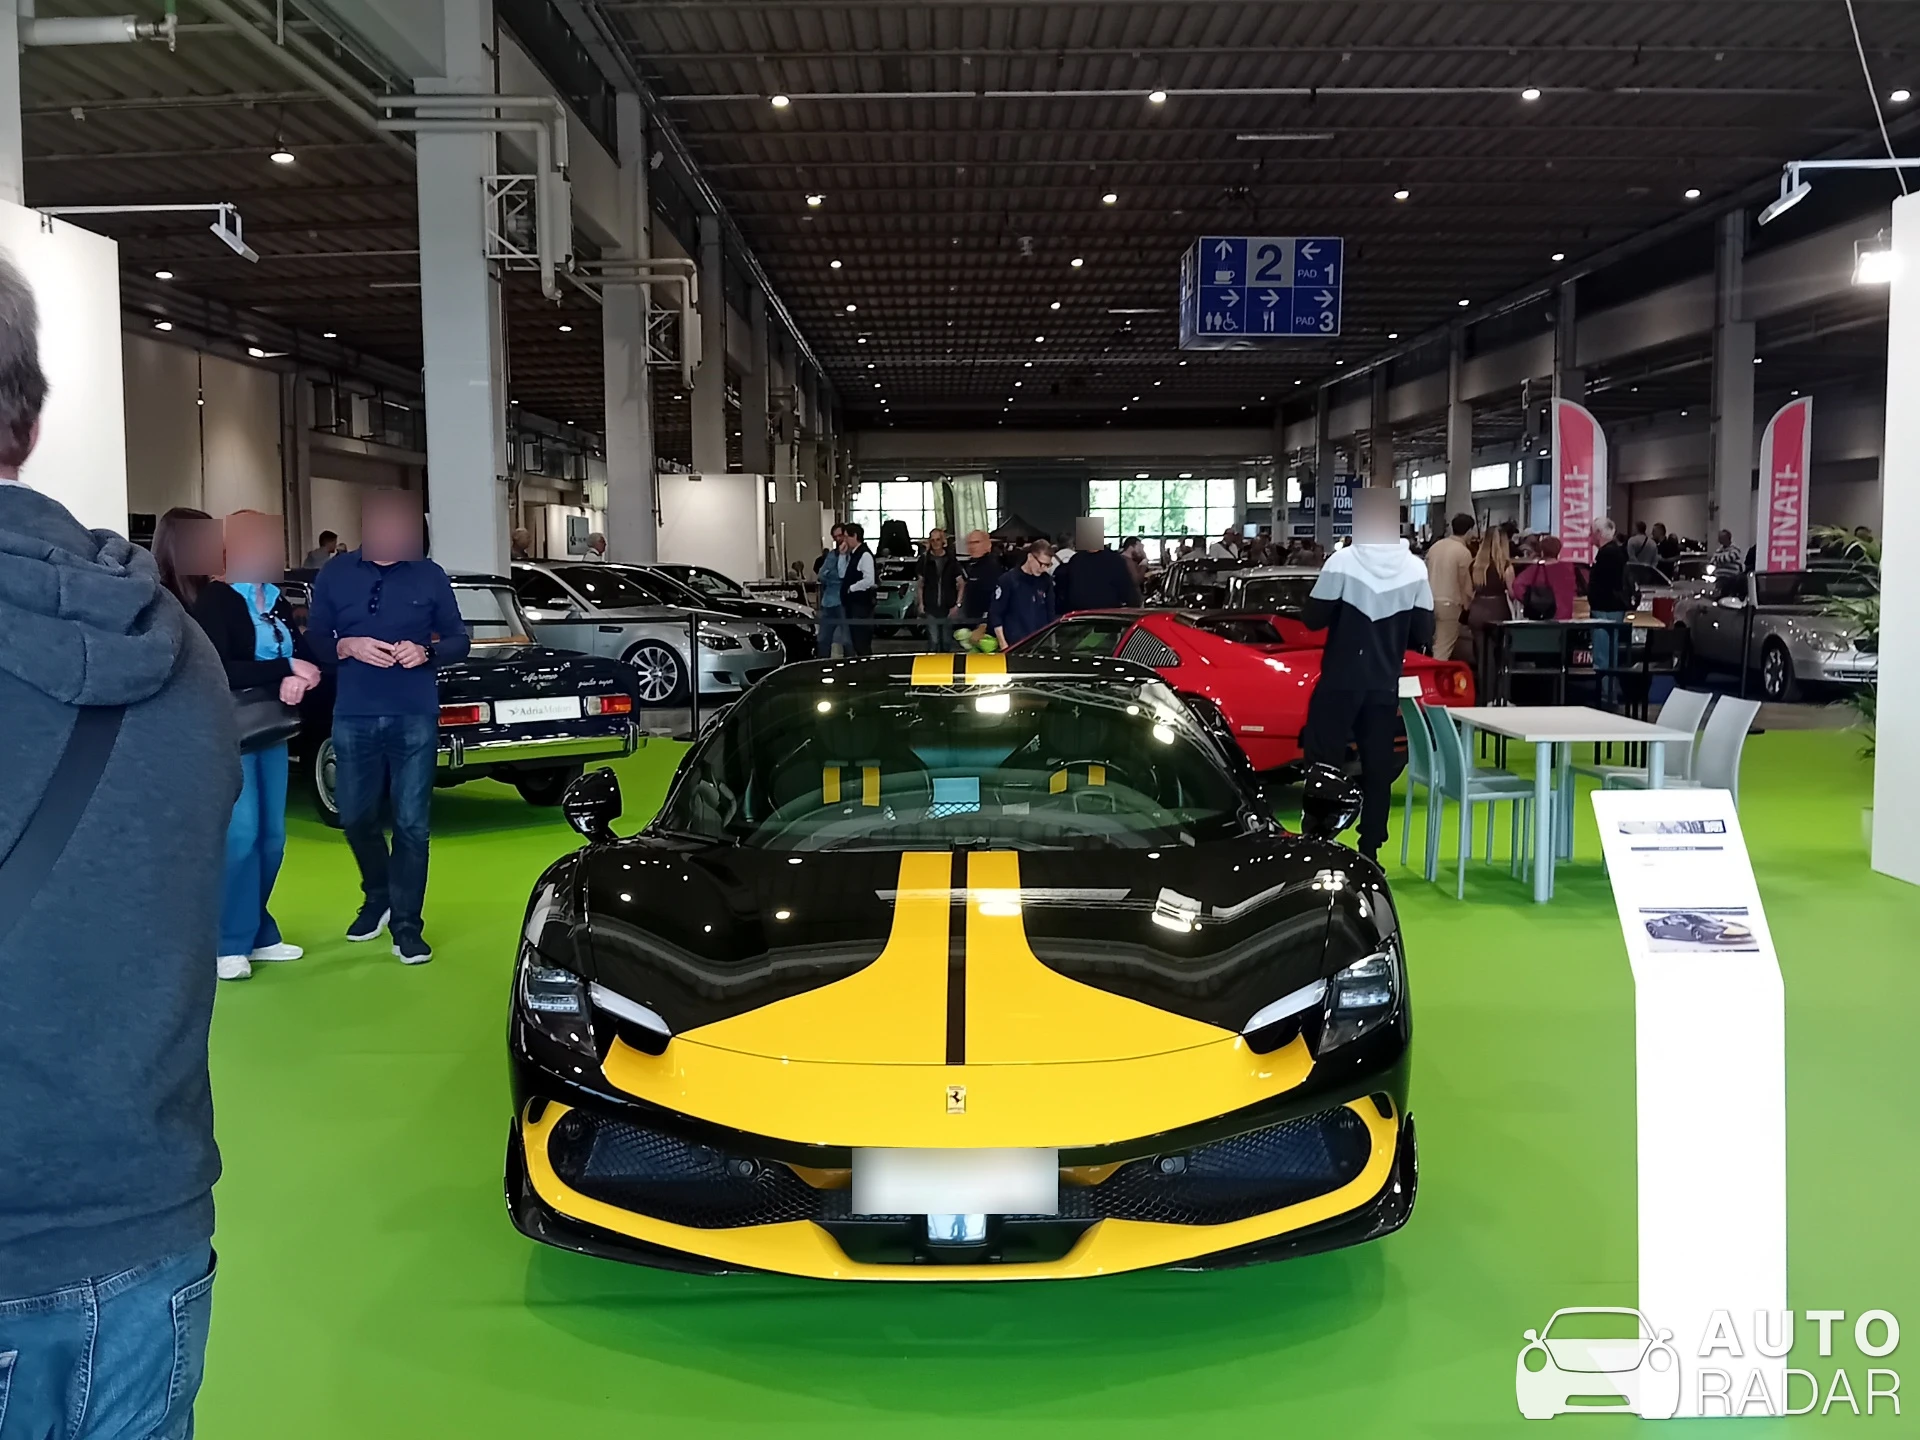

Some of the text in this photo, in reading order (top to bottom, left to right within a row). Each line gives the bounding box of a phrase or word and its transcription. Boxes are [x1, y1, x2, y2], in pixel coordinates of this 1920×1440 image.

[1255, 244, 1282, 282] 2
[1298, 263, 1334, 285] PAD 1
[1295, 311, 1334, 332] PAD 3
